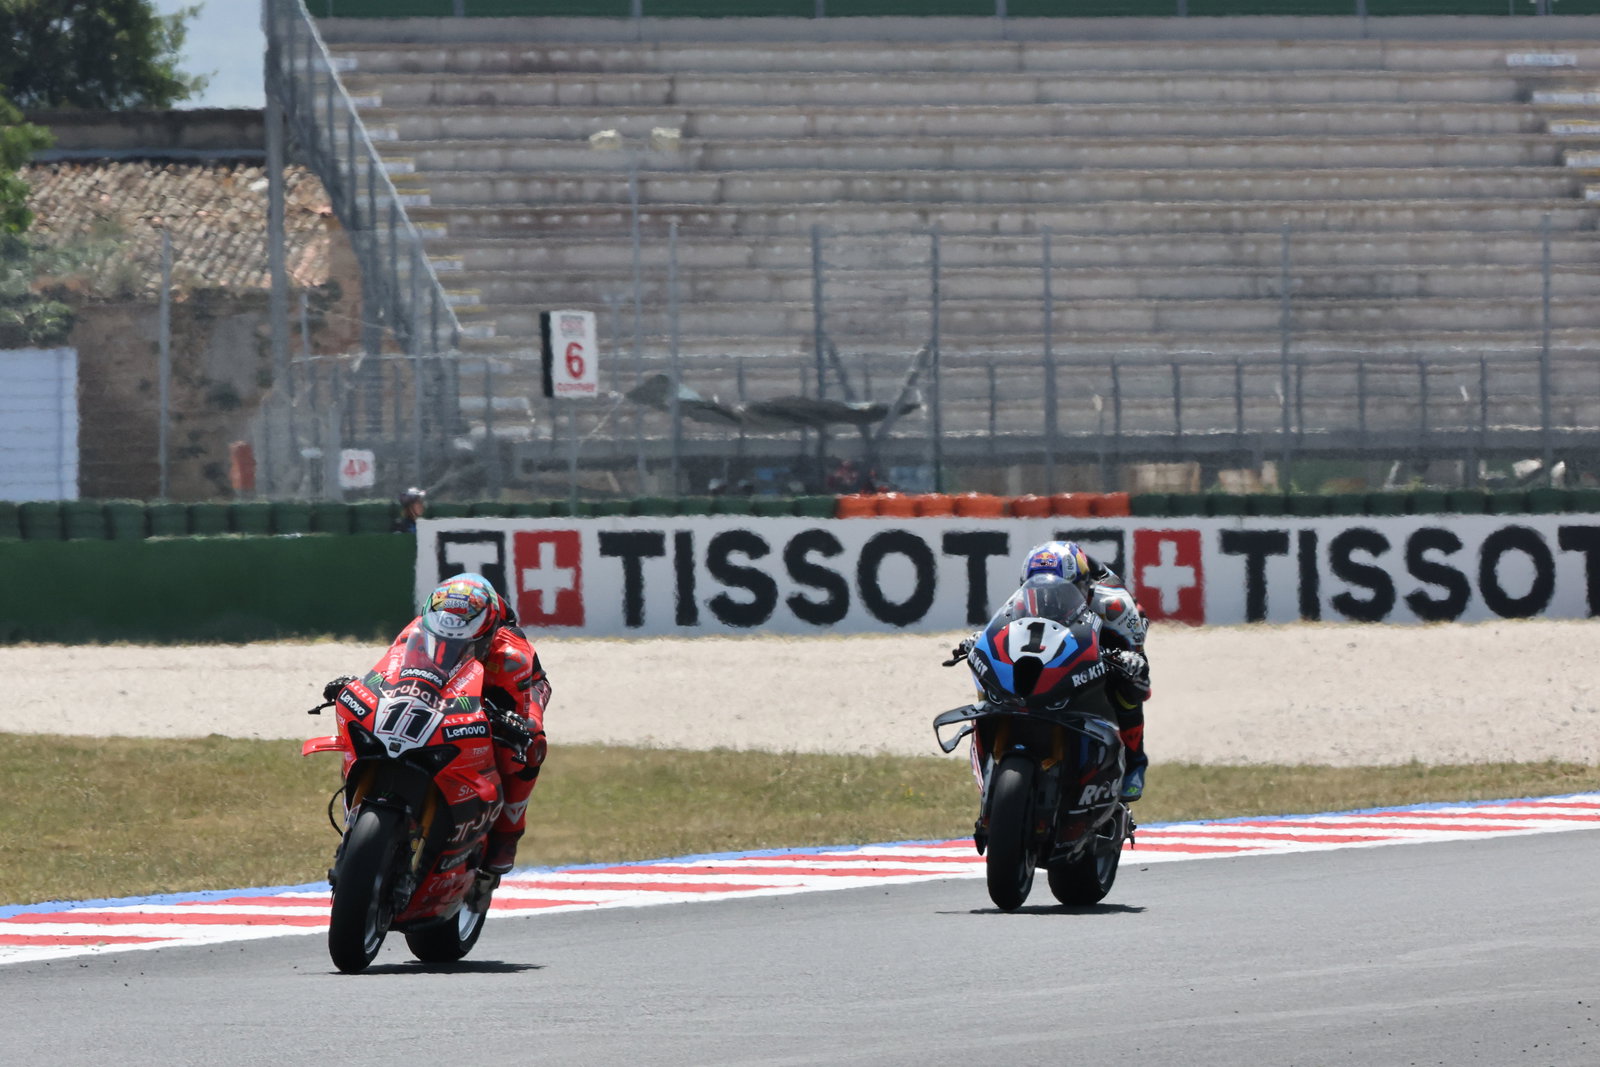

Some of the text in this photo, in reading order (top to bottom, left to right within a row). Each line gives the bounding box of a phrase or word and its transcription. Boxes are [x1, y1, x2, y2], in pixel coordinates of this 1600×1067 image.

[566, 342, 584, 379] 6
[598, 530, 1009, 628] TISSOT
[1020, 621, 1047, 654] 1
[400, 668, 443, 687] CARRERA
[339, 690, 366, 716] Lenovo
[348, 681, 376, 704] ALTEN
[384, 680, 448, 712] aruba.it
[378, 700, 436, 742] 11
[443, 714, 485, 725] ALTEN
[445, 725, 486, 739] Lenovo
